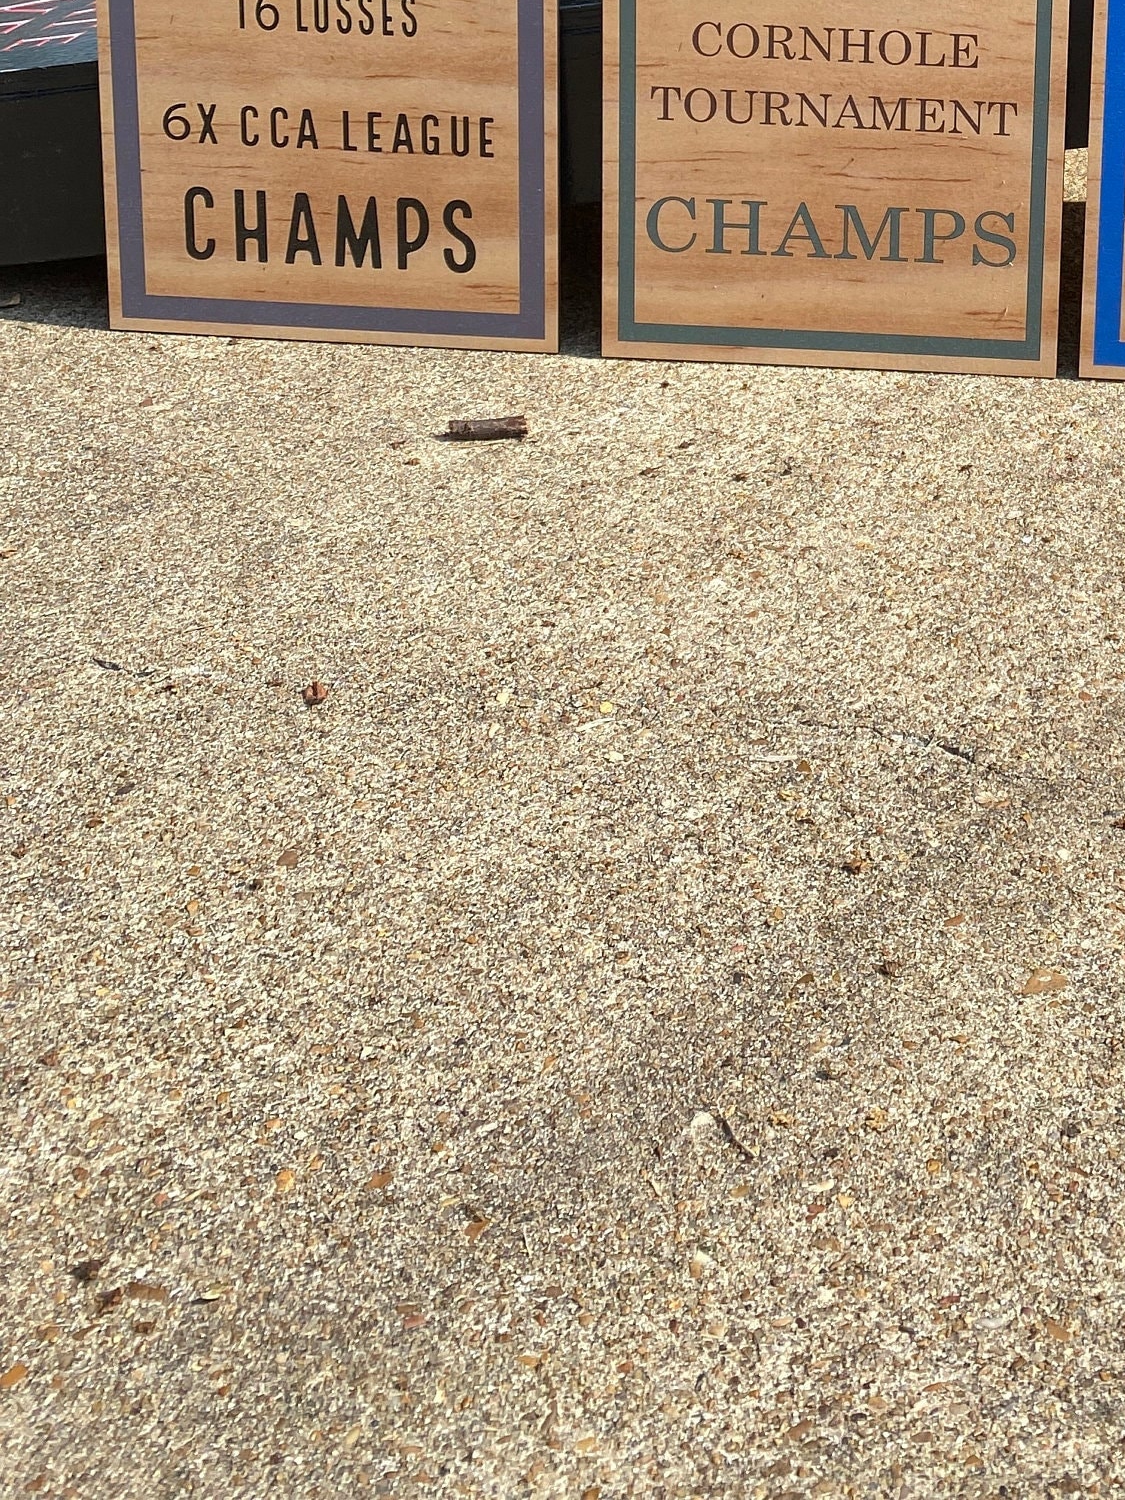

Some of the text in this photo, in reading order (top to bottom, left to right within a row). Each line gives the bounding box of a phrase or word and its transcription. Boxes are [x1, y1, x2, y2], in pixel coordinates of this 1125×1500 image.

[692, 22, 979, 69] CORNHOLE
[162, 103, 495, 158] 6X CCA LEAGUE
[650, 86, 1018, 136] TOURNAMENT
[184, 186, 477, 274] CHAMPS
[646, 196, 1017, 268] CHAMPS
